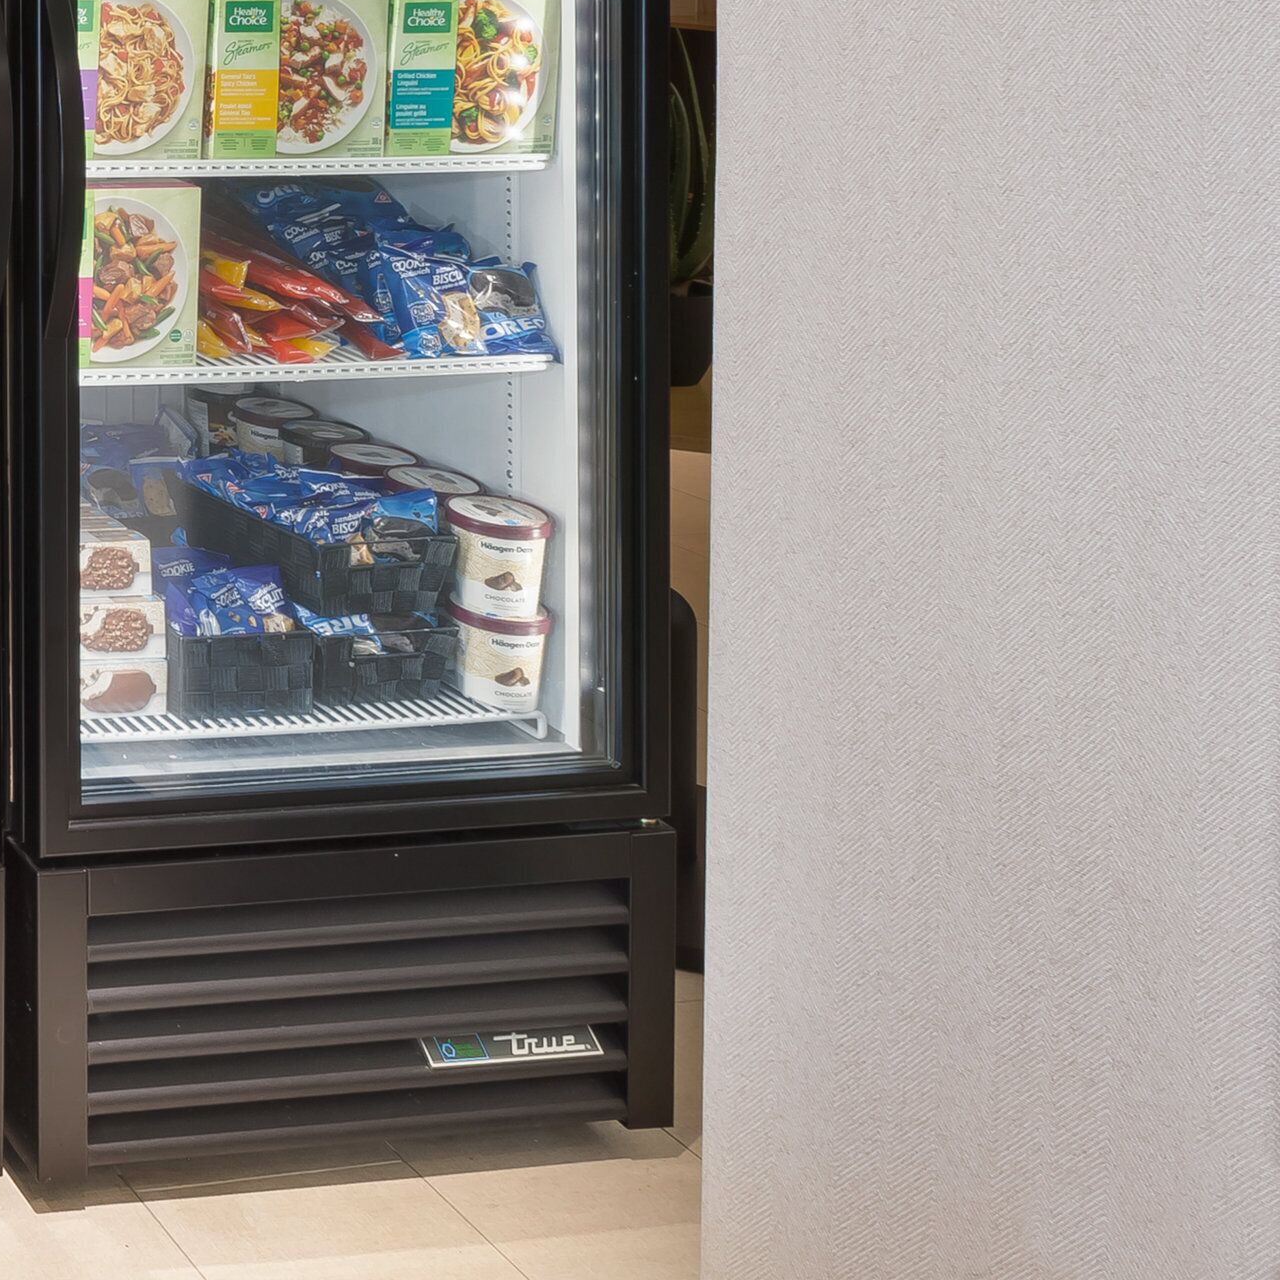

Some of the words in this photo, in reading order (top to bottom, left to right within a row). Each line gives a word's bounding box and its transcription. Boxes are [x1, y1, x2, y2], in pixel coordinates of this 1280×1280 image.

[234, 7, 266, 18] Healthy
[413, 8, 446, 19] Healthy
[229, 14, 268, 26] Choice
[407, 16, 446, 28] Choice
[484, 317, 546, 341] OREO
[493, 1031, 586, 1056] true
